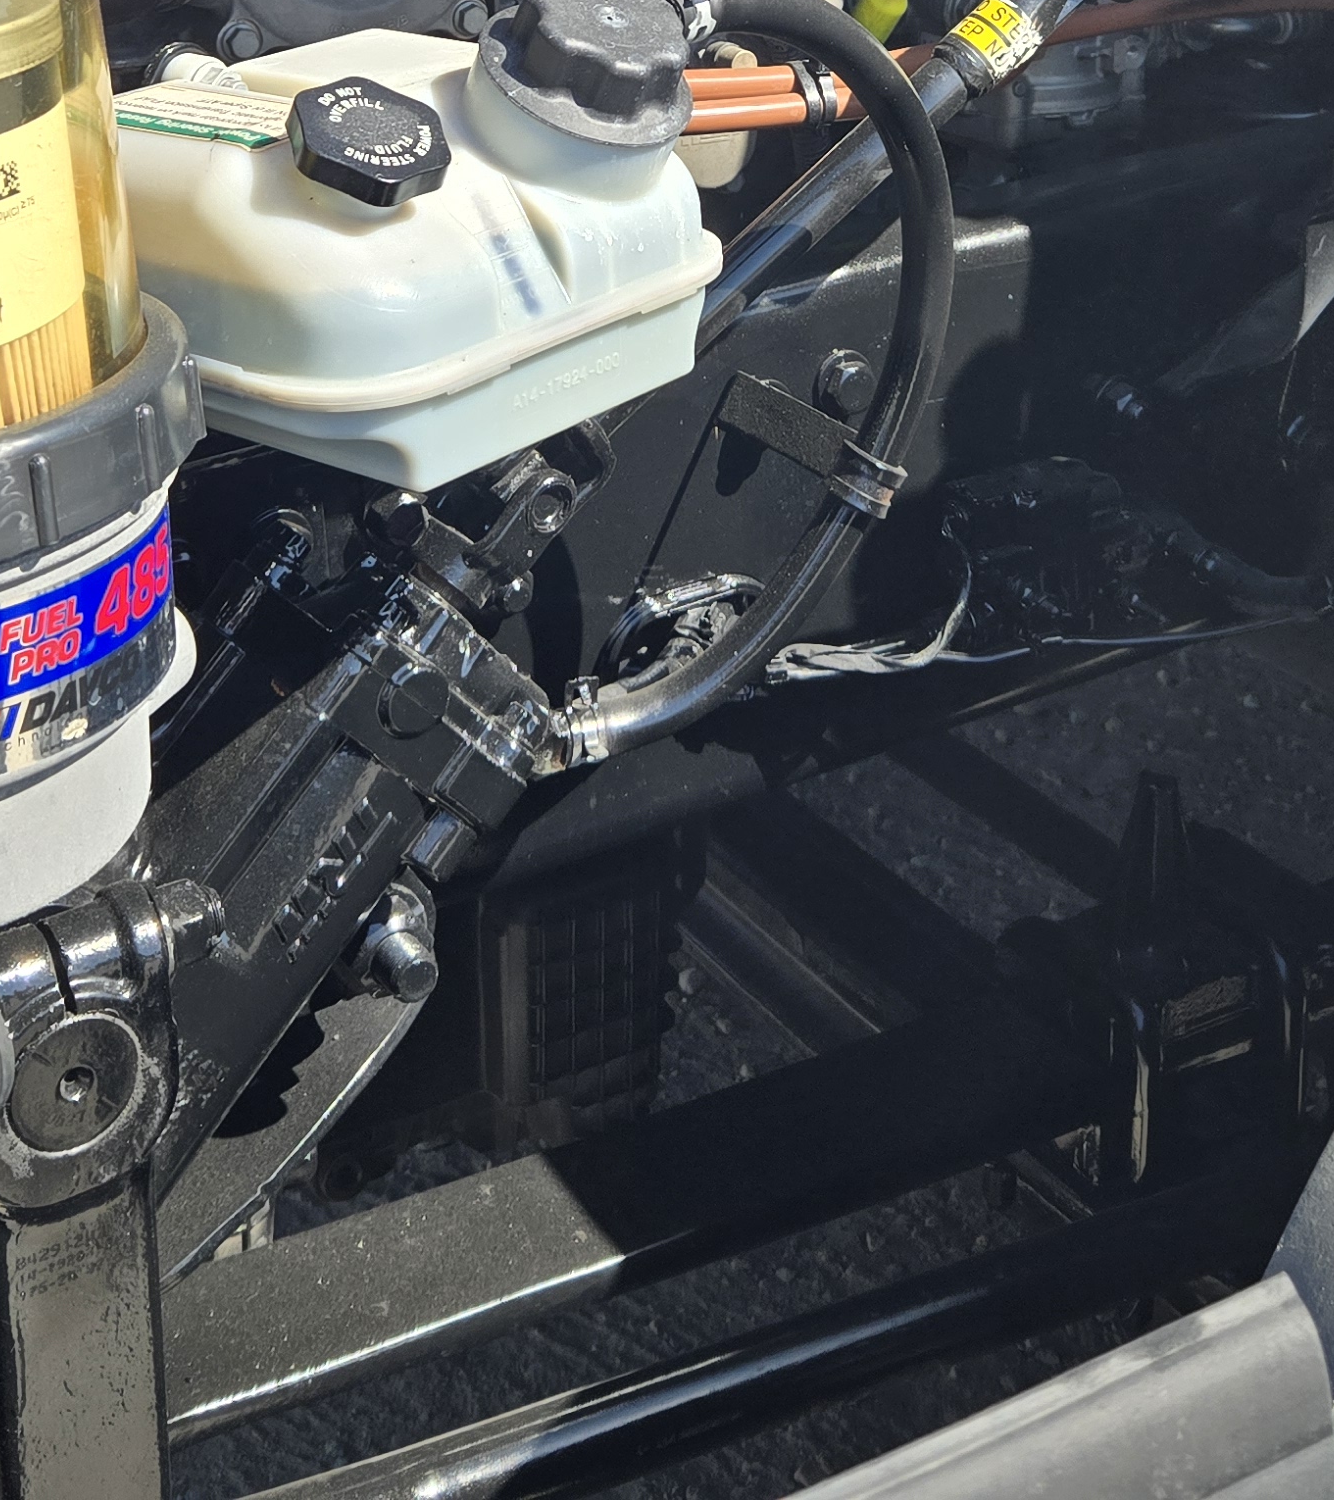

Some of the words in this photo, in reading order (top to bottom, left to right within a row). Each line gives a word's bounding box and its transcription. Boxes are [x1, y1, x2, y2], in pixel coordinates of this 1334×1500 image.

[317, 92, 336, 107] DO
[335, 86, 363, 98] NOT
[328, 97, 385, 124] OVERFILL
[344, 146, 416, 167] STEERING
[374, 135, 414, 156] FLUID
[94, 521, 169, 636] 485
[8, 628, 82, 686] PRO
